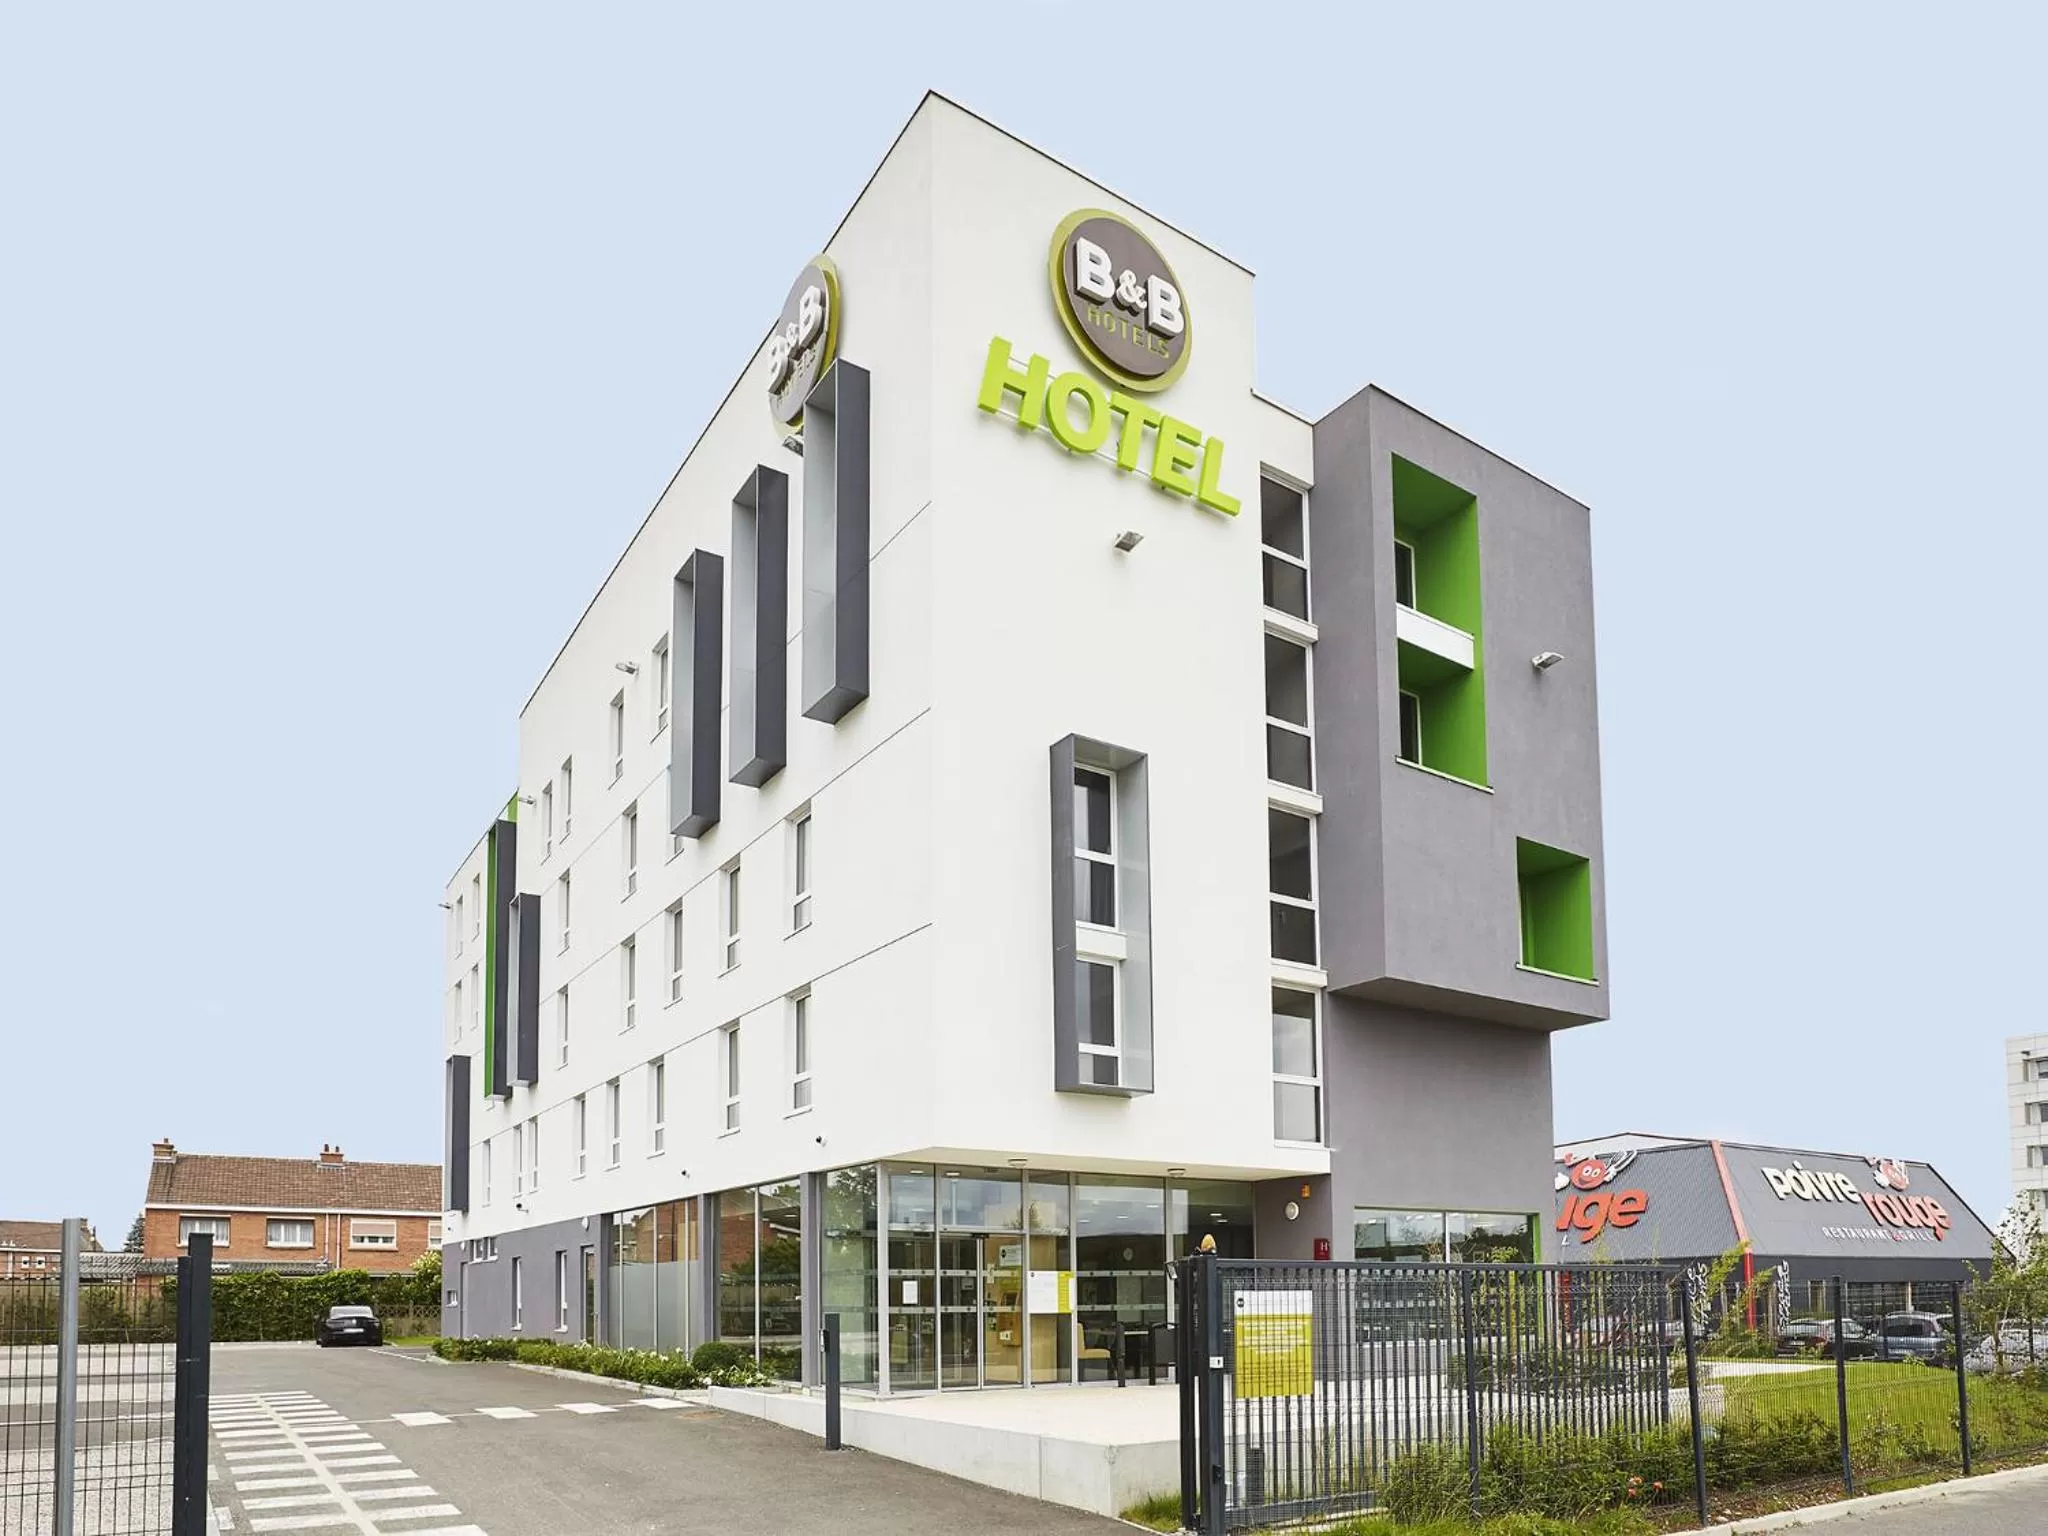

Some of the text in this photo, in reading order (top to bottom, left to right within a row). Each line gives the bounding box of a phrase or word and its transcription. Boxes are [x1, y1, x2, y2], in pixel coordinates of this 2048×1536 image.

[1074, 236, 1184, 336] B&B
[768, 285, 823, 393] B&B
[1087, 303, 1169, 358] HOTELS
[977, 336, 1240, 517] HOTEL
[1761, 1160, 1861, 1204] poivre
[1822, 1226, 1893, 1240] RESTAURANT
[1860, 1193, 1951, 1240] rouge
